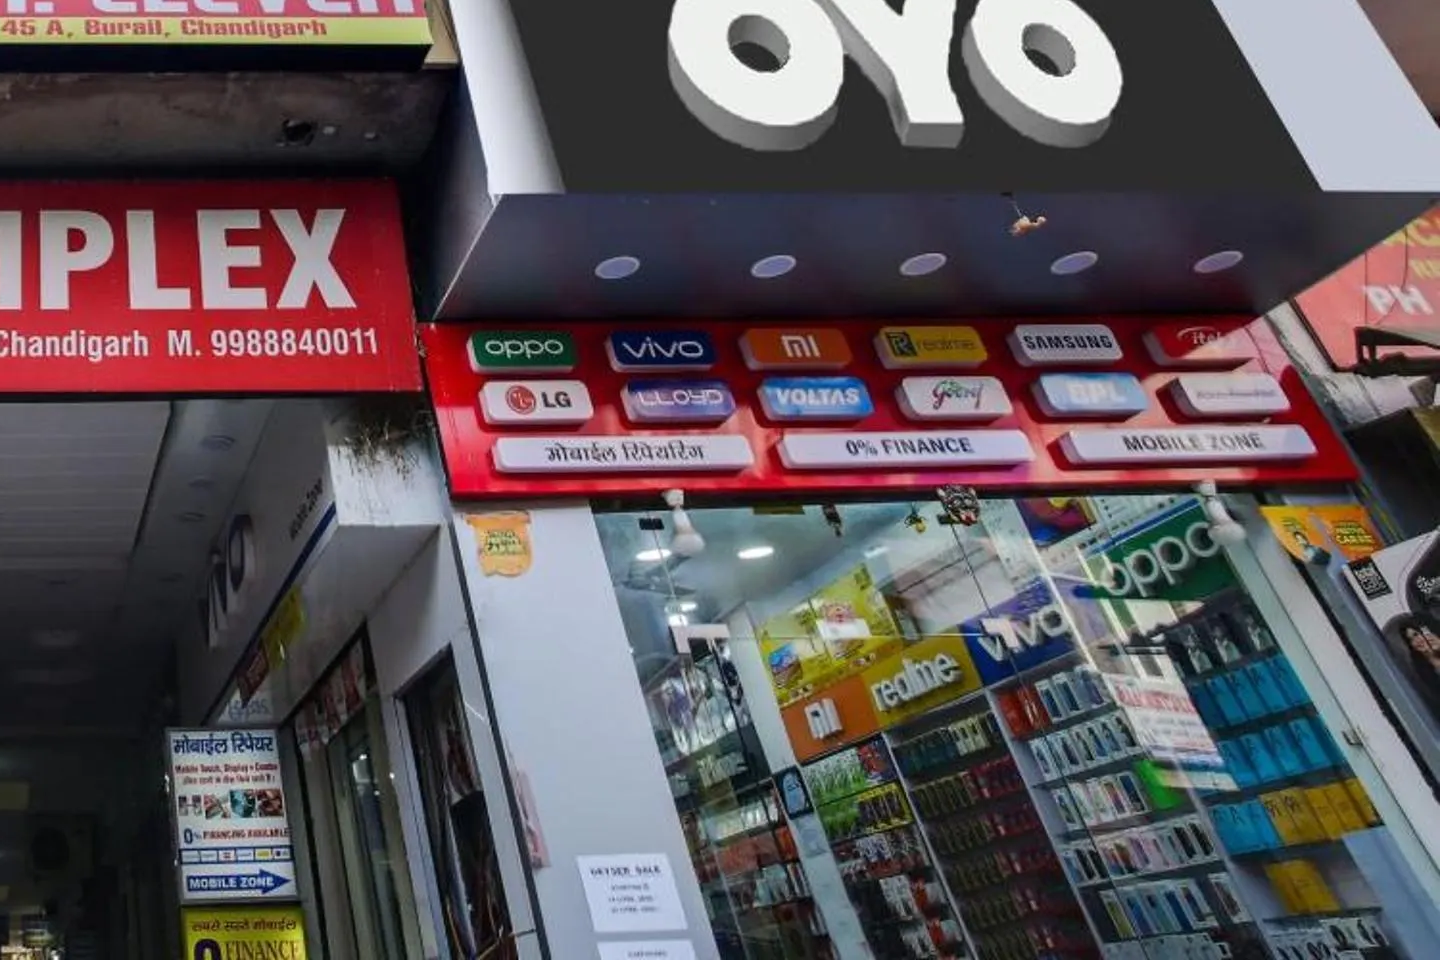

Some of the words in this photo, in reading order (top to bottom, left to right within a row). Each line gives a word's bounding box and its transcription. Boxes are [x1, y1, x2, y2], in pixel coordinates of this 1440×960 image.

[0, 19, 37, 36] 45
[83, 19, 169, 39] Burail,
[180, 19, 327, 39] Chandigarh
[167, 330, 202, 356] M.
[210, 327, 379, 356] 9988840011
[485, 339, 564, 359] oppo
[622, 336, 704, 358] vivo
[1022, 335, 1114, 350] SAMSUNG
[776, 387, 860, 406] VOLTAS
[845, 439, 878, 457] 0%
[881, 437, 975, 455] FINANCE
[1122, 434, 1207, 452] MOBILE
[1211, 433, 1266, 451] ZONE
[978, 606, 1066, 662] vvo
[871, 650, 962, 714] realme
[189, 876, 237, 889] MOBILE
[239, 875, 274, 888] ZONE
